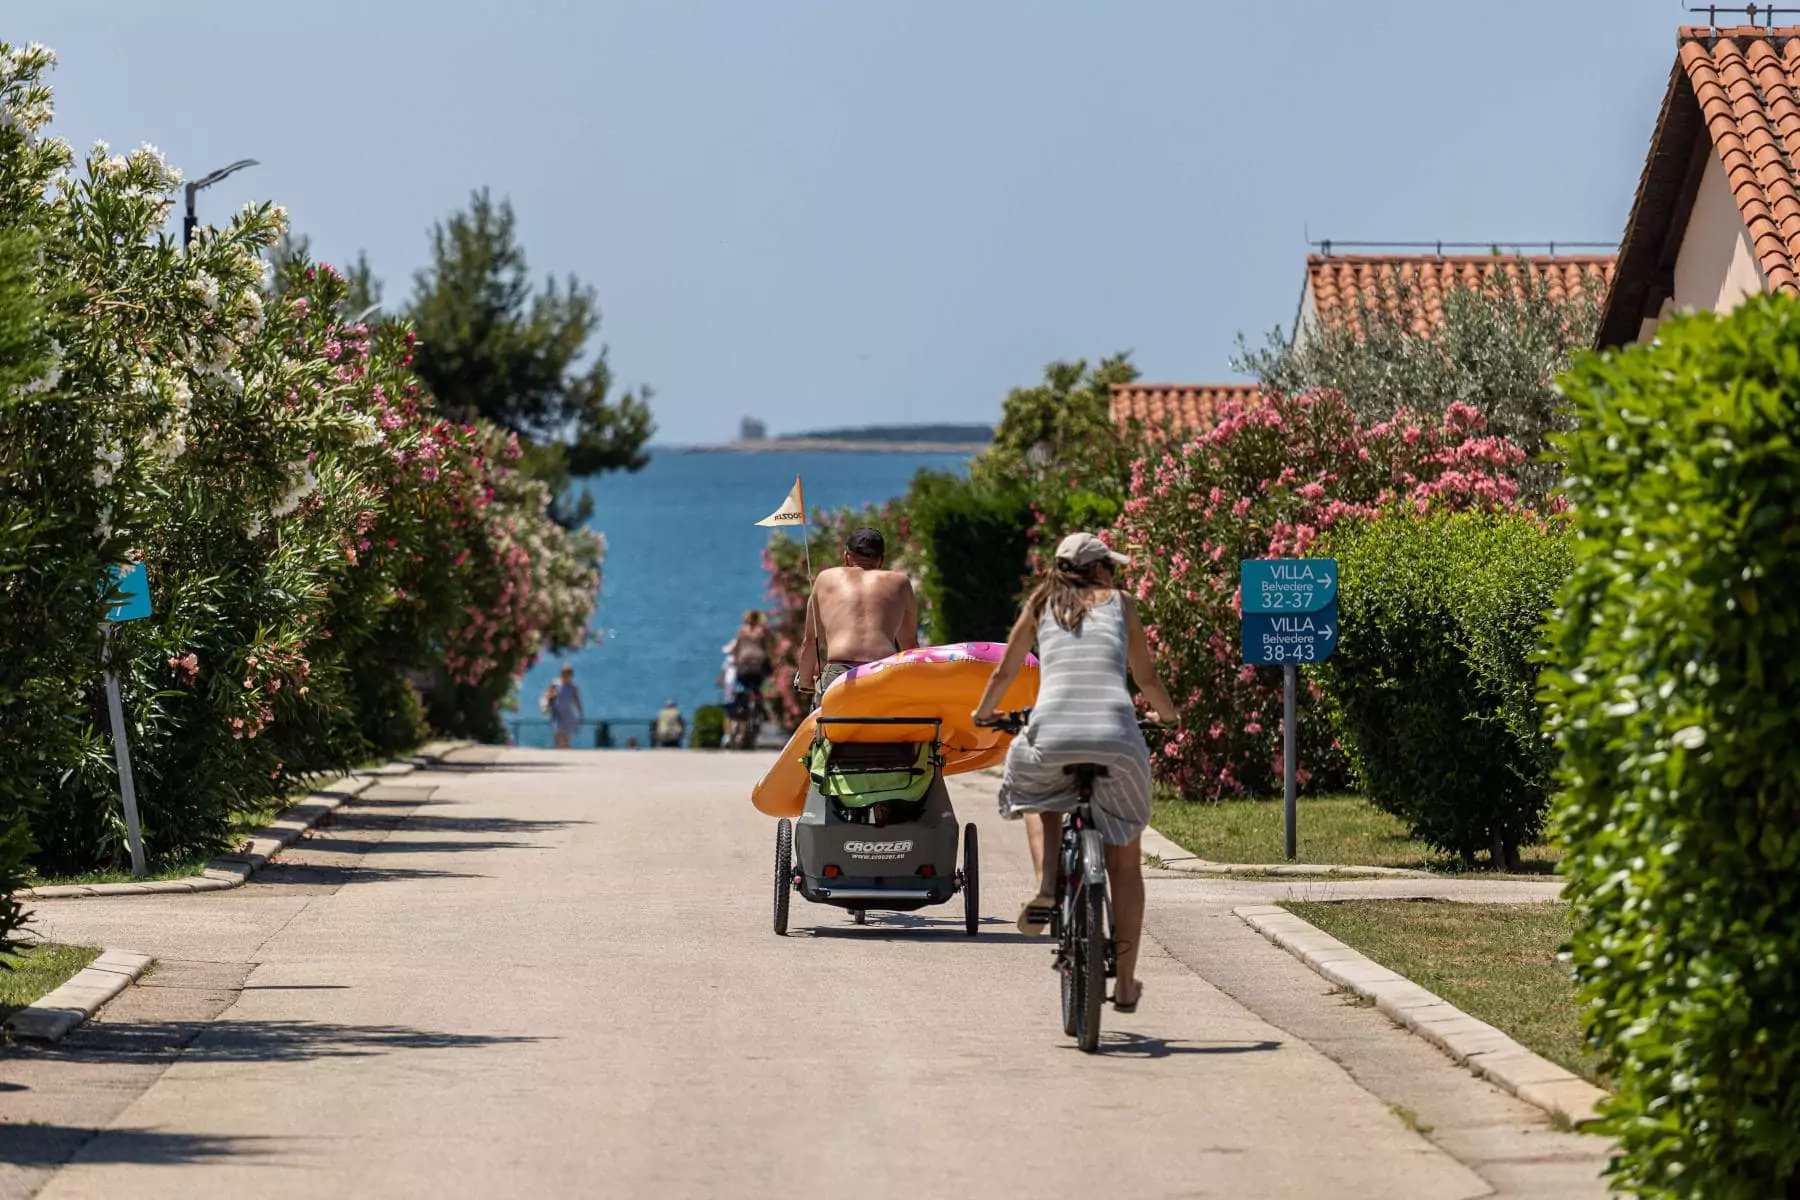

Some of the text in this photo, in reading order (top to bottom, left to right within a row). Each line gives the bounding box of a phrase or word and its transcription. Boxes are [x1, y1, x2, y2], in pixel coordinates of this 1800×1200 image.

[1270, 565, 1314, 579] VILLA
[1261, 581, 1314, 591] Belvedere
[1261, 592, 1313, 608] 32-37
[1270, 617, 1315, 632] VILLA
[1262, 633, 1314, 644] Belvedere
[1263, 645, 1315, 661] 38-43
[844, 841, 913, 853] CROOZER
